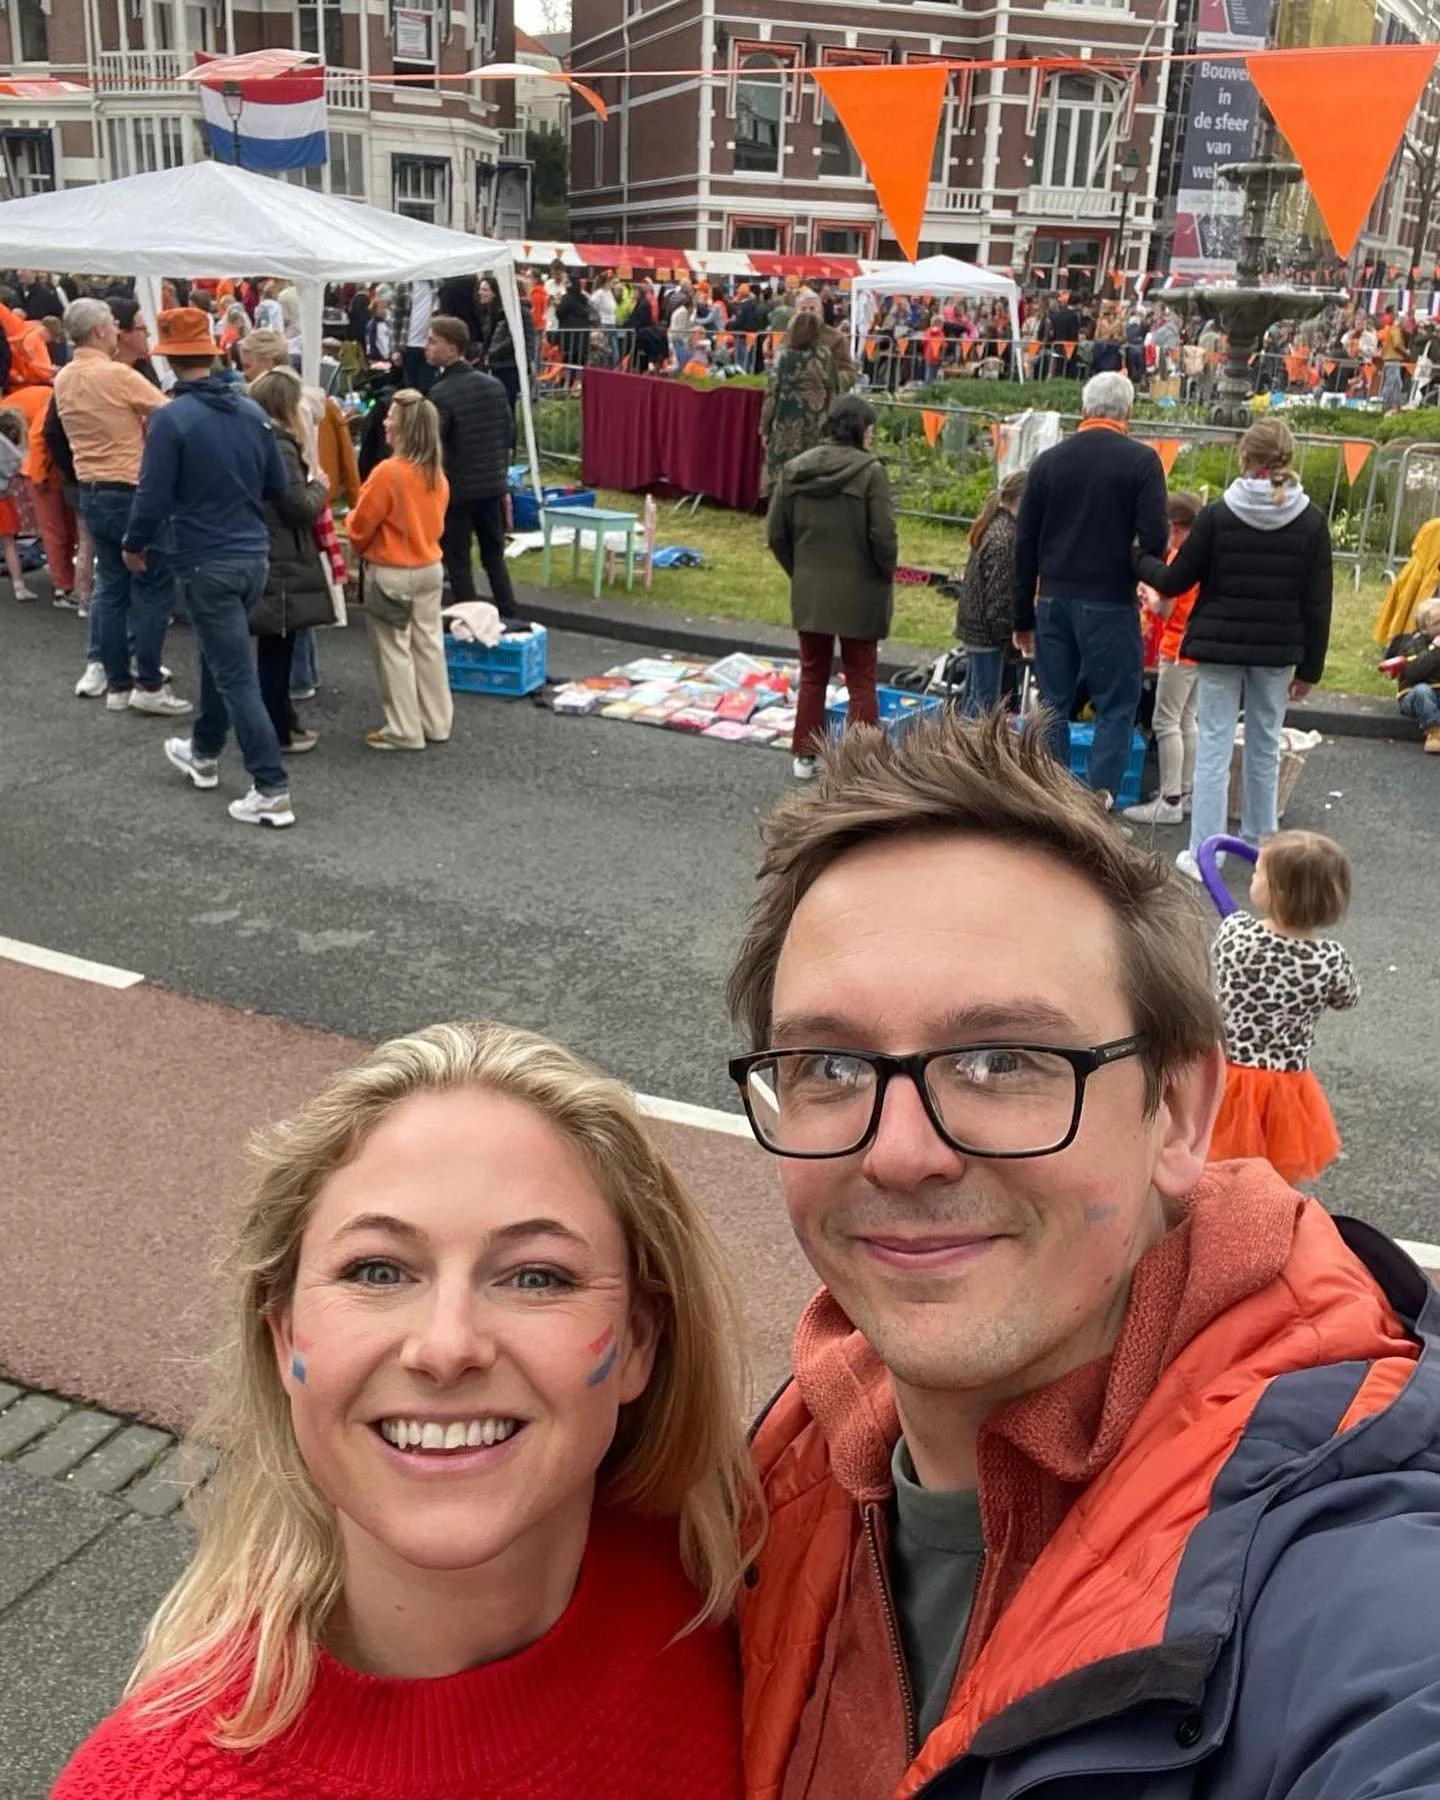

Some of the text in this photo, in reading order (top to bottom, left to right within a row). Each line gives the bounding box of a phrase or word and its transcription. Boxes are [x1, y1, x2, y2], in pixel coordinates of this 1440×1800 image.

[1218, 87, 1232, 105] in
[1194, 110, 1249, 132] de sfeer
[1206, 141, 1232, 155] van
